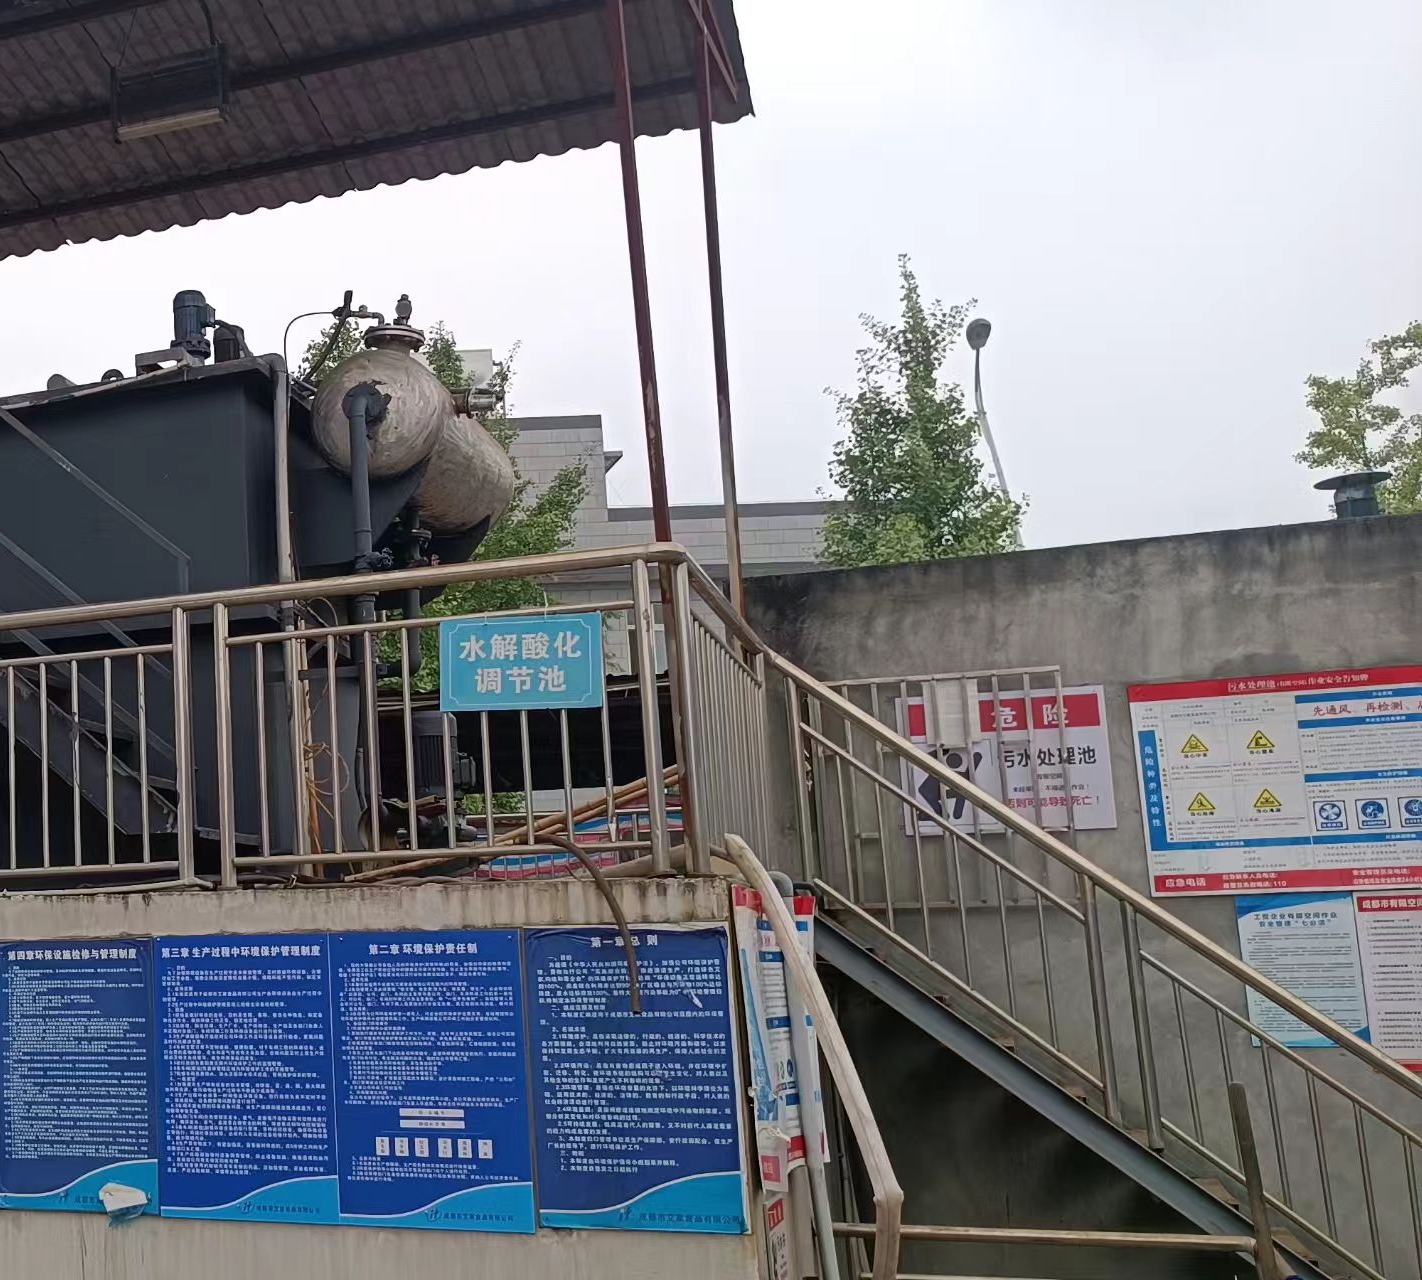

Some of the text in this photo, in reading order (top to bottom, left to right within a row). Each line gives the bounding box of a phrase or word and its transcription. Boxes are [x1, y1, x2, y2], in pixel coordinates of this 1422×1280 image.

[459, 631, 582, 662] 水解酸化
[474, 665, 567, 694] 调节池
[1165, 877, 1207, 887] 应急电话
[161, 945, 321, 959] 第三章 生产过程中环境保护管理制度
[369, 942, 478, 955] 第二章 环境保护责任制
